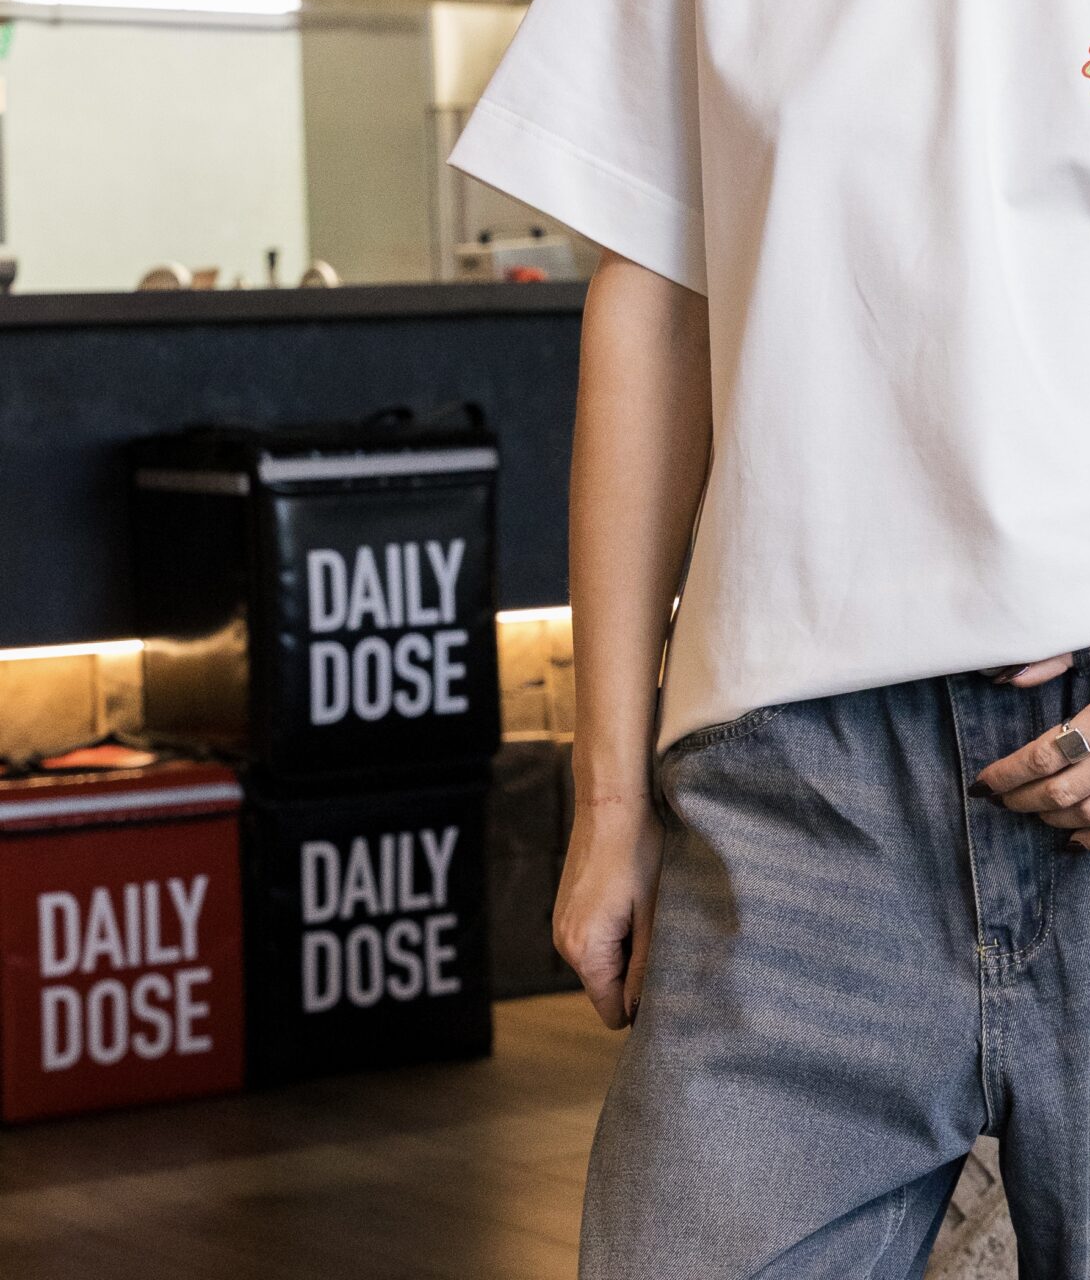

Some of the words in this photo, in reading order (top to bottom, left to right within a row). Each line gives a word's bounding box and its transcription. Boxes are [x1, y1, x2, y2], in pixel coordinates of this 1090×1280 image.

[307, 538, 465, 632] DAILY
[310, 630, 469, 724] DOSE
[301, 826, 459, 923] DAILY
[38, 874, 209, 978] DAILY
[303, 914, 461, 1011] DOSE
[41, 967, 212, 1070] DOSE
